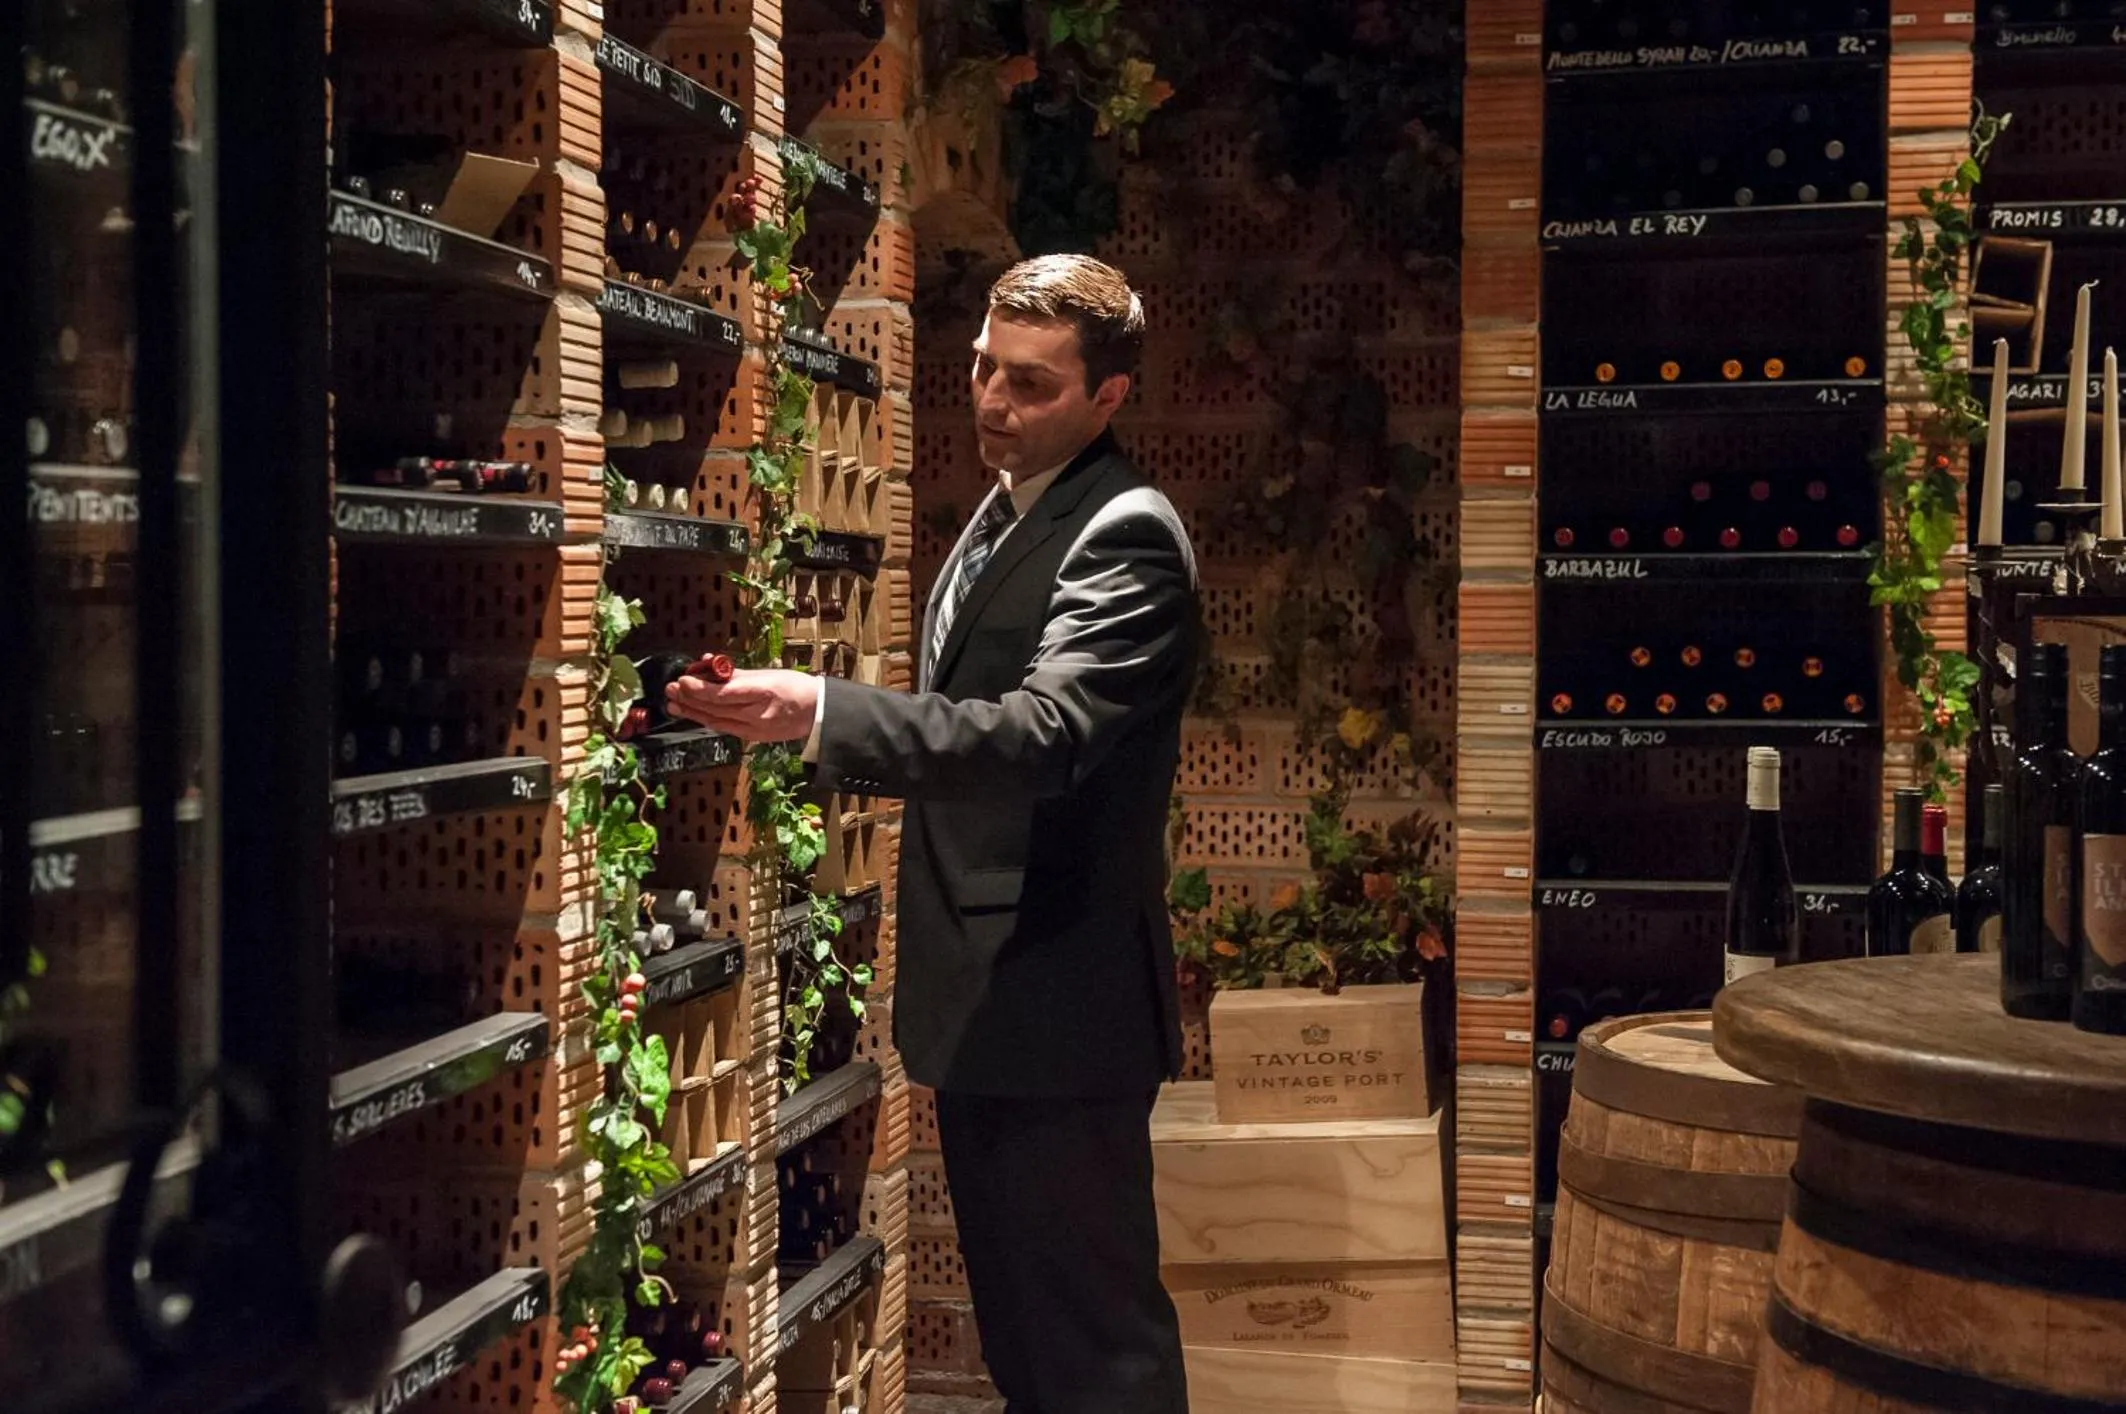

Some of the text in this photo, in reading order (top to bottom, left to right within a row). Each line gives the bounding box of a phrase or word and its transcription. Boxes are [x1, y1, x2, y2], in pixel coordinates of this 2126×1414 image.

[1637, 47, 1685, 66] SYRAH
[1838, 37, 1877, 56] 22,-
[1630, 217, 1655, 235] EL
[1665, 215, 1707, 236] REY
[1989, 209, 2063, 228] PROMIS
[1545, 389, 1858, 410] LA LEGUA 13,-
[2007, 383, 2062, 400] AGARI
[1544, 558, 1649, 579] BARBAZUL
[1542, 731, 1612, 749] ESCUDO
[1620, 728, 1667, 747] ROJO
[1542, 889, 1597, 908] ENEO
[1250, 1050, 1379, 1067] TAYLOR'S
[1236, 1072, 1407, 1089] VINTAGE PORT
[1304, 1094, 1339, 1105] 2009
